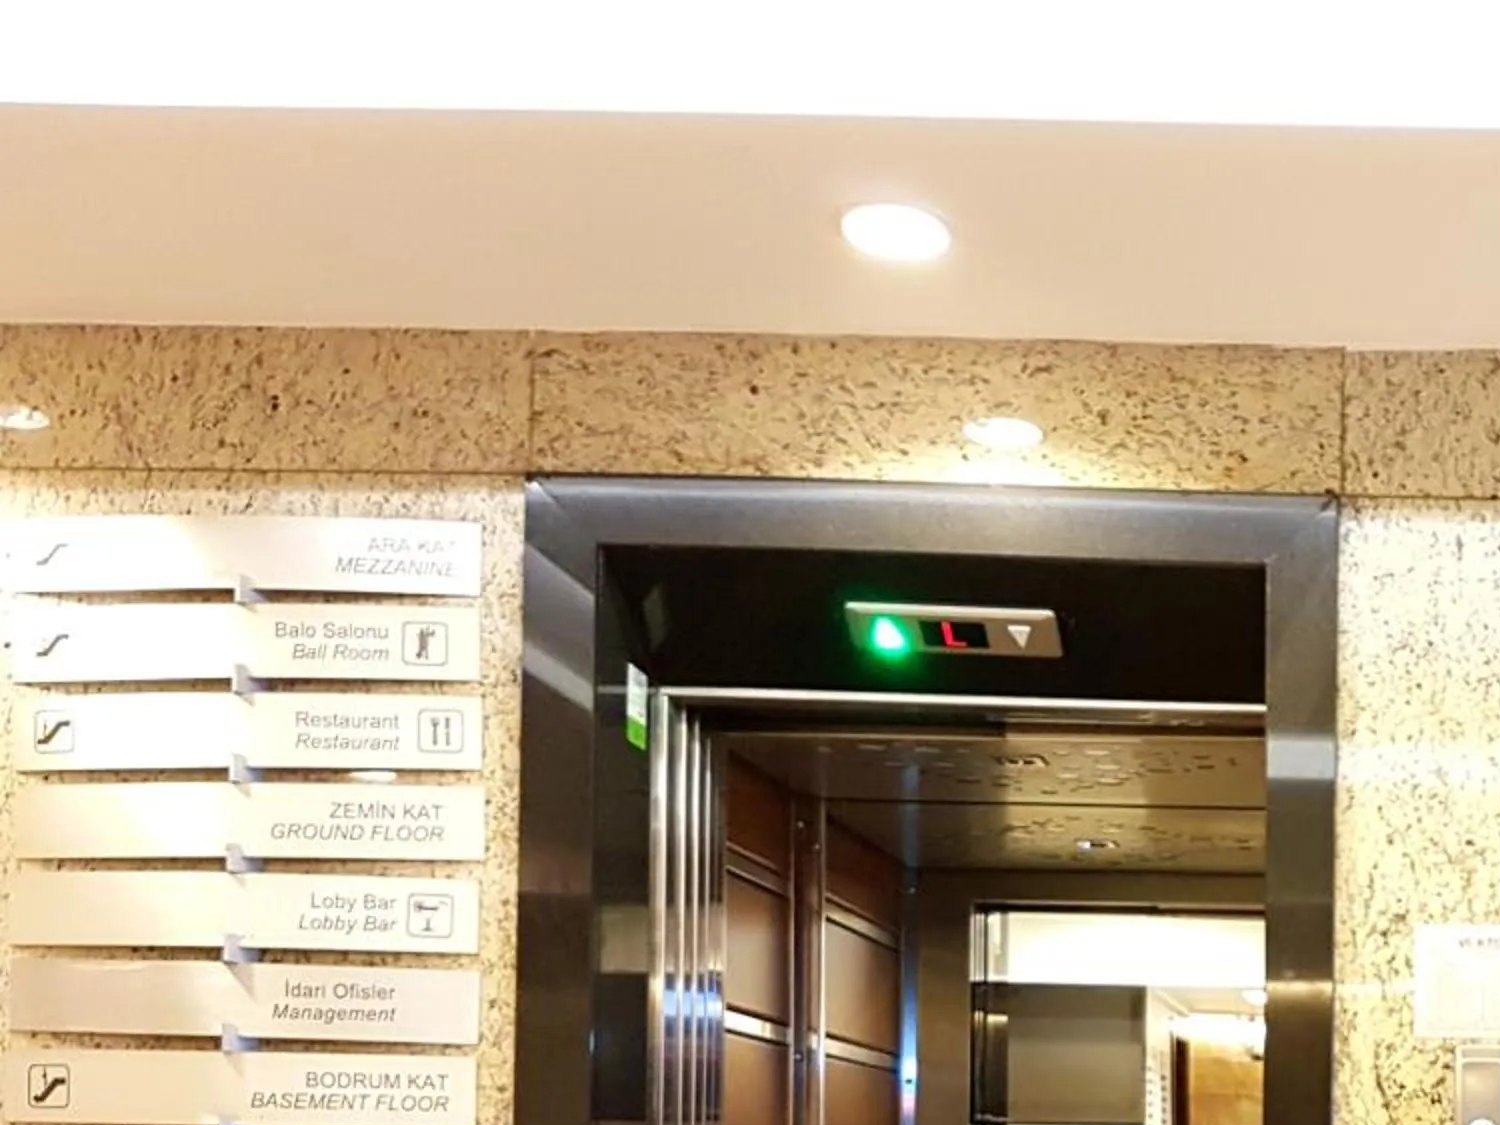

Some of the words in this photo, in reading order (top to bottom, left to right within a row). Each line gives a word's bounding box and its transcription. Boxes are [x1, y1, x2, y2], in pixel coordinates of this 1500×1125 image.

[335, 557, 455, 576] MEZZANINE
[275, 621, 316, 638] Balo
[323, 622, 388, 639] Salonu
[941, 622, 967, 647] L
[292, 644, 327, 659] Ball
[332, 644, 389, 660] Room
[295, 711, 398, 728] Restaurant
[295, 733, 399, 750] Restaurant
[403, 804, 442, 821] KAT
[271, 823, 364, 840] GROUND
[370, 825, 444, 842] FLOOR
[311, 892, 357, 913] Loby
[363, 893, 396, 910] Bar
[298, 912, 357, 935] Lobby
[363, 915, 396, 932] Bar
[333, 983, 395, 1000] Ofisler
[272, 1004, 395, 1025] Management
[306, 1072, 400, 1089] BODRUM
[408, 1074, 448, 1090] KAT
[250, 1092, 369, 1110] BASEMENT
[375, 1094, 449, 1112] FLOOR
